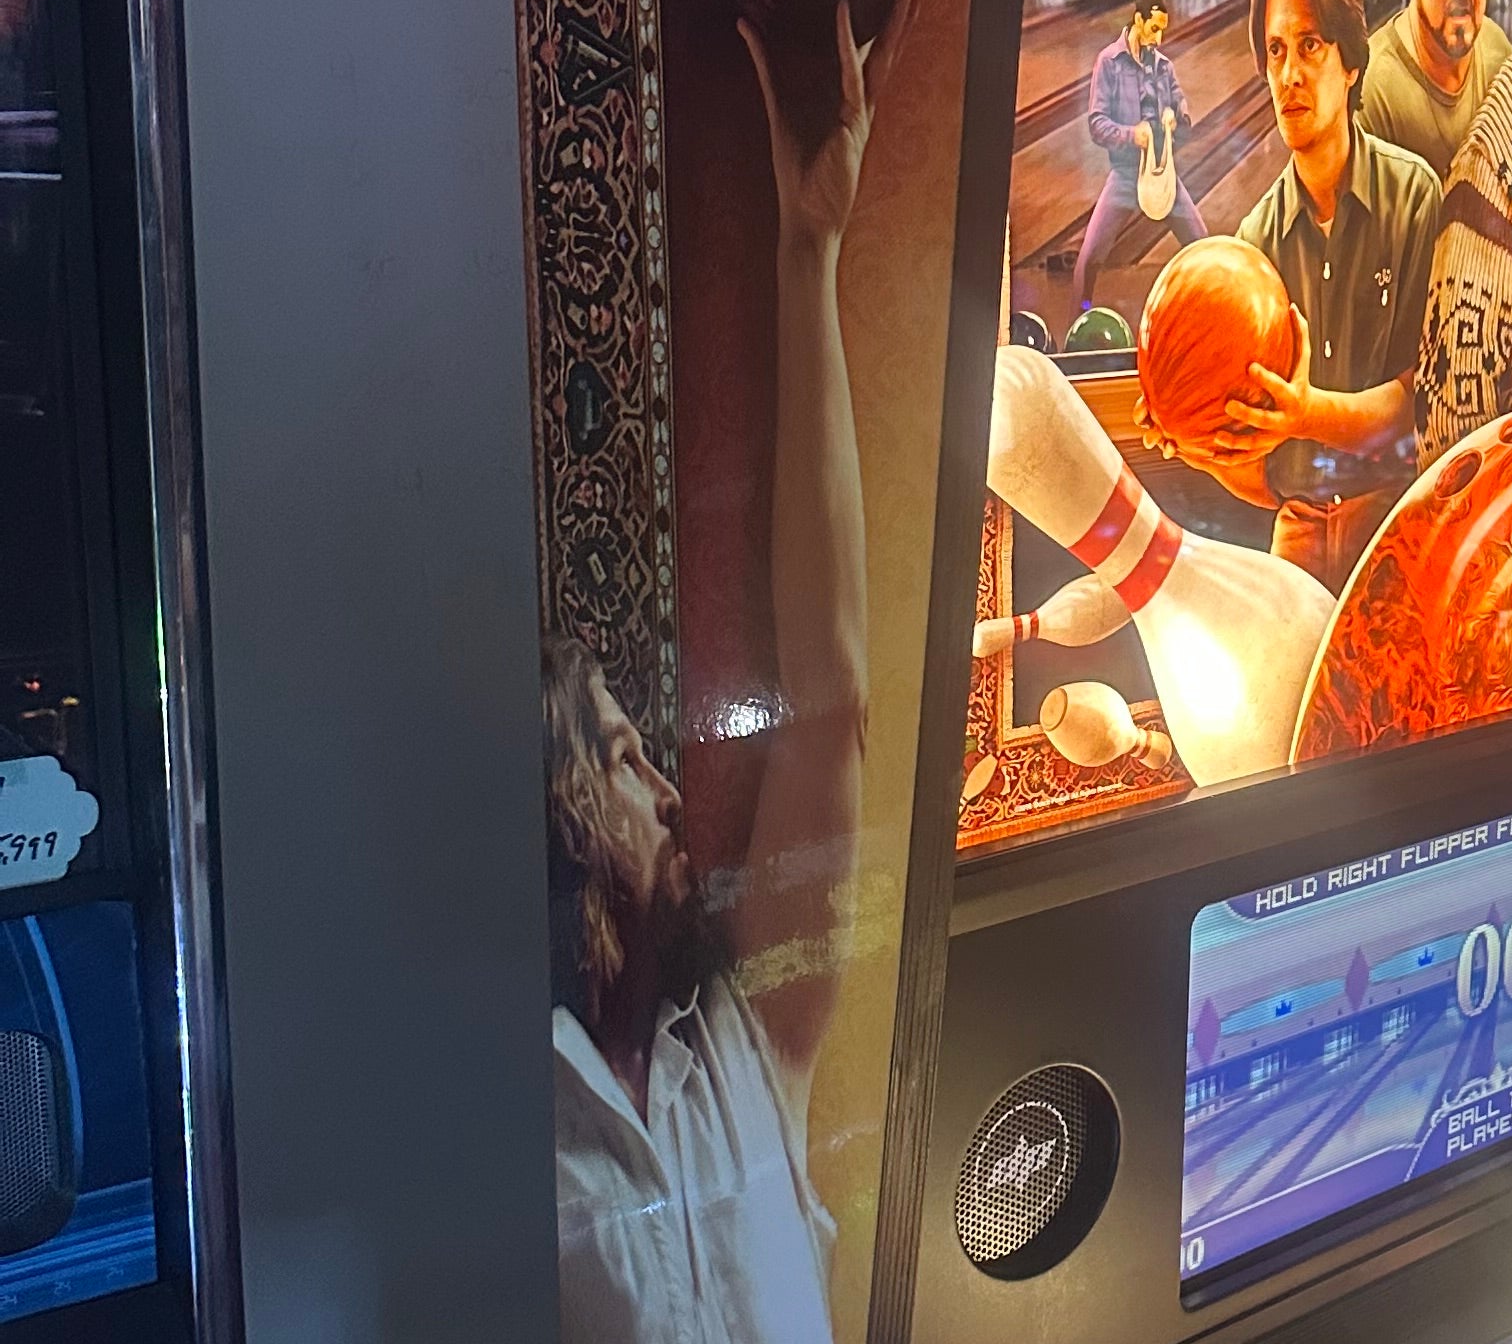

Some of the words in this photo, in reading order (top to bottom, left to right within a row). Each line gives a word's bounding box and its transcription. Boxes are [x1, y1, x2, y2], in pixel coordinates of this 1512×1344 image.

[1254, 876, 1318, 914] HOLD
[1327, 853, 1392, 892] RIGHT
[1400, 824, 1489, 869] FLIPPER
[1447, 1099, 1501, 1135] BALL
